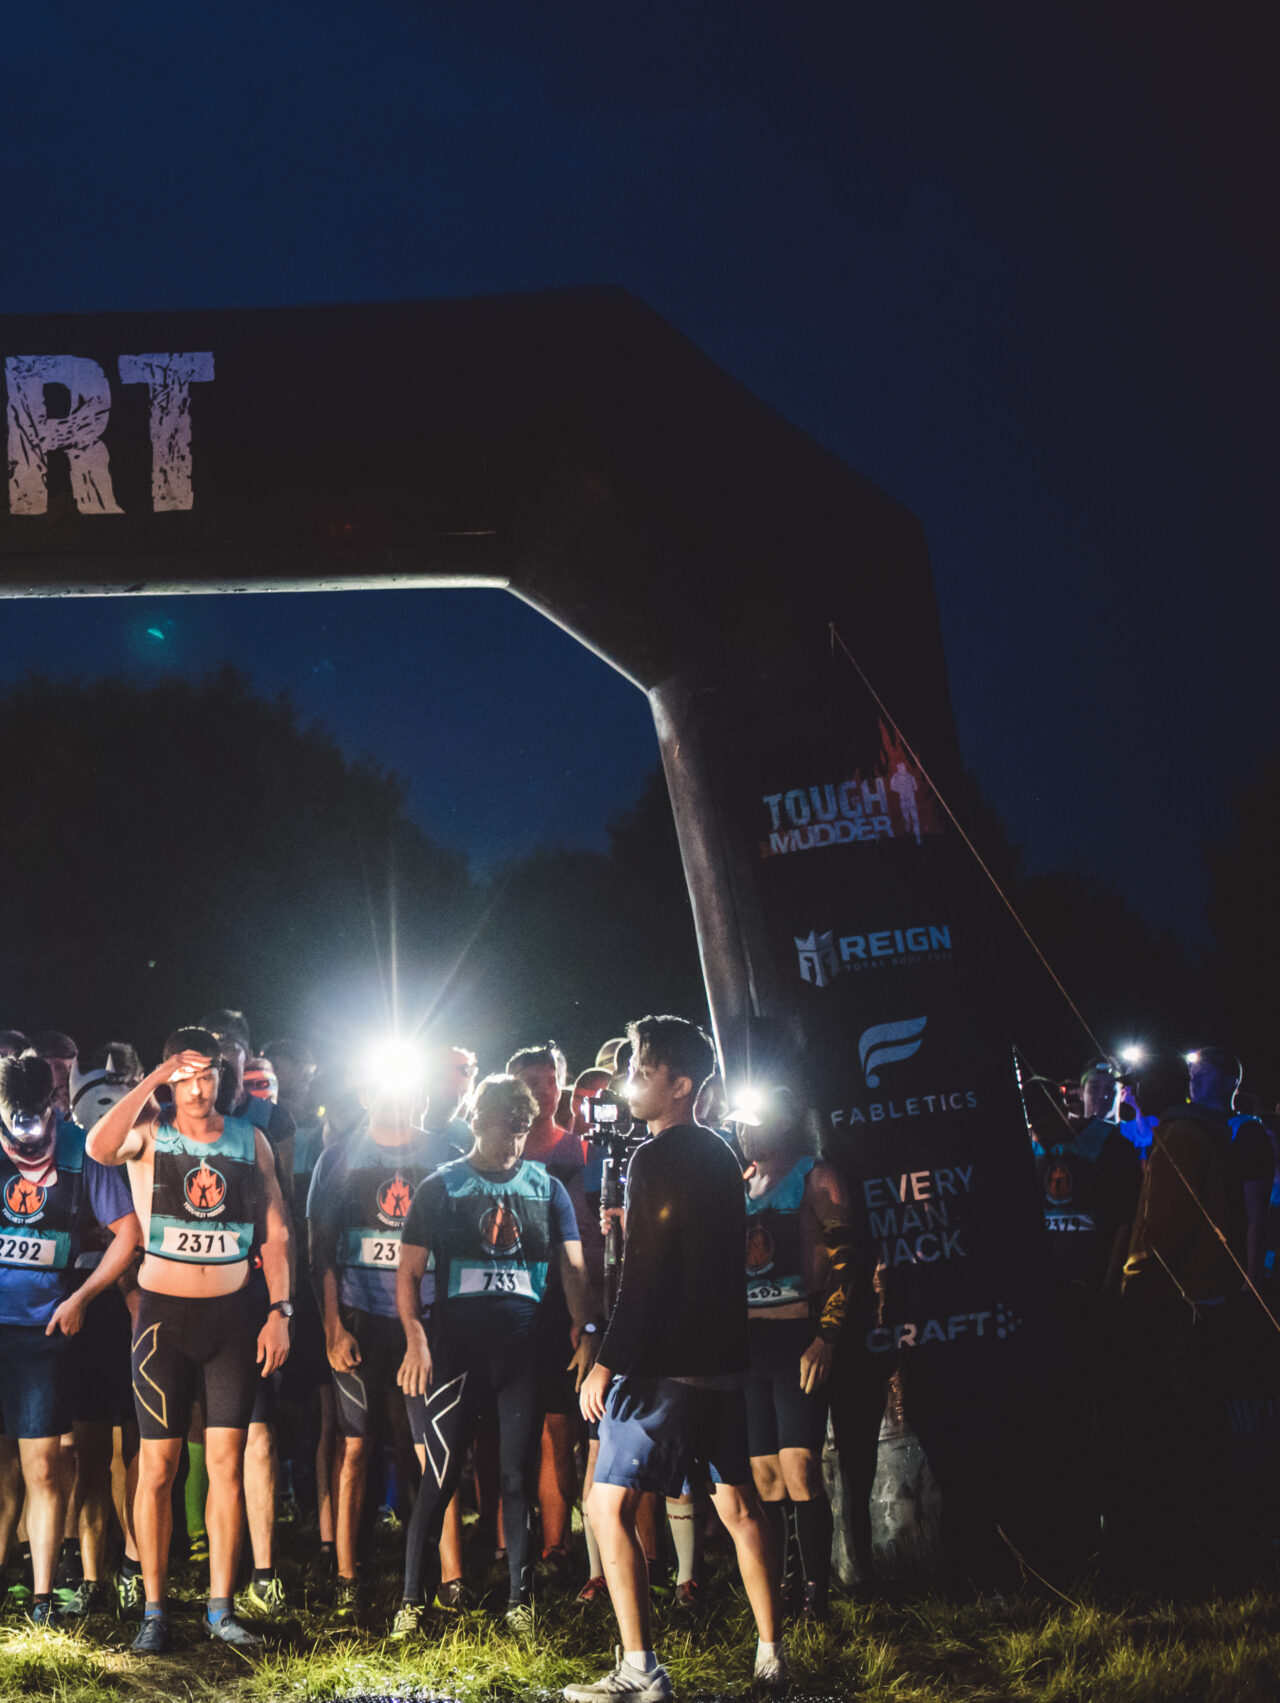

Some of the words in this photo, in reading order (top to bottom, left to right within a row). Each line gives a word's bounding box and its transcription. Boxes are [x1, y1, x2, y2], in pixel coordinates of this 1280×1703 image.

[762, 777, 888, 831] TOUGH
[769, 816, 895, 855] MUDDER
[839, 925, 952, 961] REIGN
[831, 1092, 977, 1128] FABLETICS
[863, 1165, 973, 1208] EVERY
[869, 1200, 949, 1239] MAN
[176, 1233, 225, 1254] 2371
[373, 1242, 401, 1262] 23
[876, 1229, 966, 1270] JACK
[483, 1272, 516, 1292] 733
[865, 1311, 991, 1353] CRAFT
